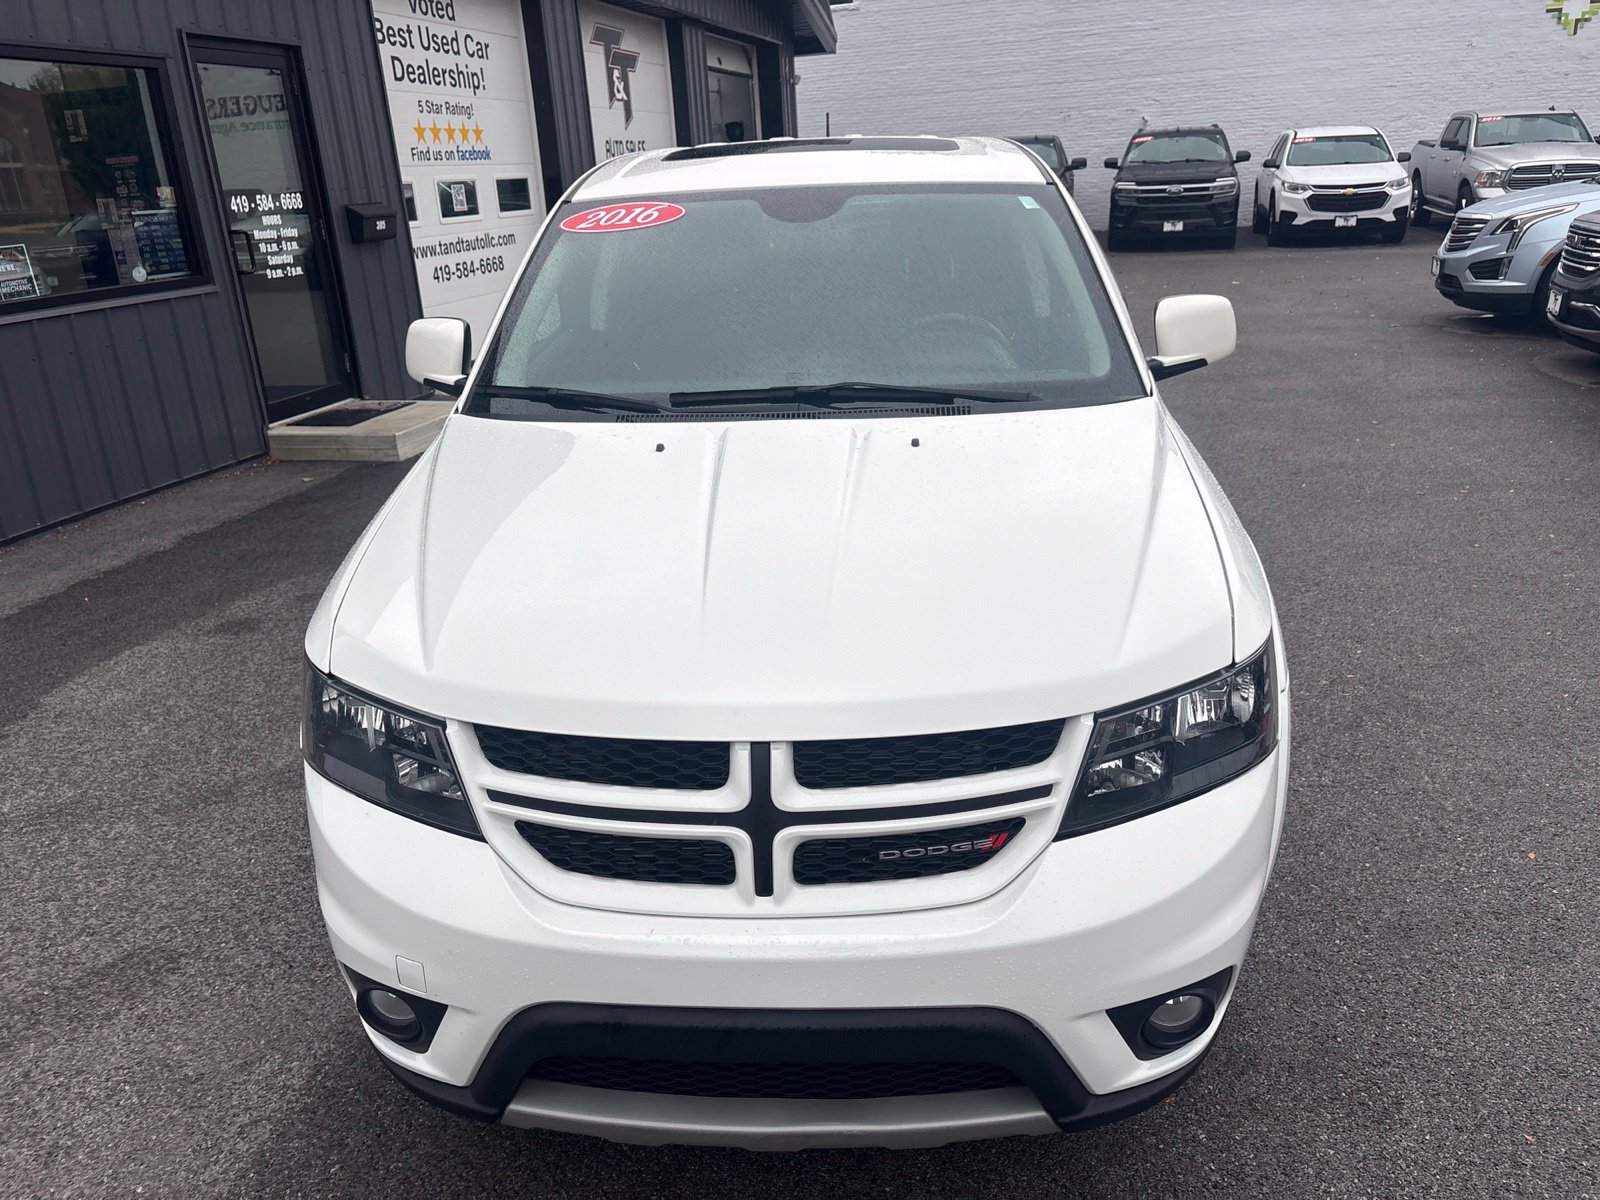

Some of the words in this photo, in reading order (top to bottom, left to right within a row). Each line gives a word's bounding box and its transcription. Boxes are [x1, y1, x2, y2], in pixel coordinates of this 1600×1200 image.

[374, 17, 414, 49] Best
[417, 25, 460, 56] Used
[464, 34, 489, 60] Car
[390, 56, 486, 96] Dealership!
[418, 100, 424, 114] 5
[425, 101, 443, 115] Star
[445, 101, 474, 119] Rating!
[410, 147, 431, 162] Find
[433, 150, 443, 161] us
[444, 151, 455, 161] on
[456, 145, 491, 161] facebook
[605, 139, 625, 160] AUTO
[231, 195, 249, 213] 419
[256, 193, 274, 211] 584
[280, 193, 303, 210] 6668
[262, 214, 282, 226] HOURS
[575, 204, 670, 229] 2016
[253, 229, 277, 240] Monday
[280, 227, 298, 238] Friday
[259, 242, 266, 253] 10
[267, 254, 294, 266] Saturday
[433, 255, 504, 283] 419-584-6668
[266, 268, 272, 279] 9
[287, 266, 291, 276] 2
[879, 837, 993, 860] DODGE
